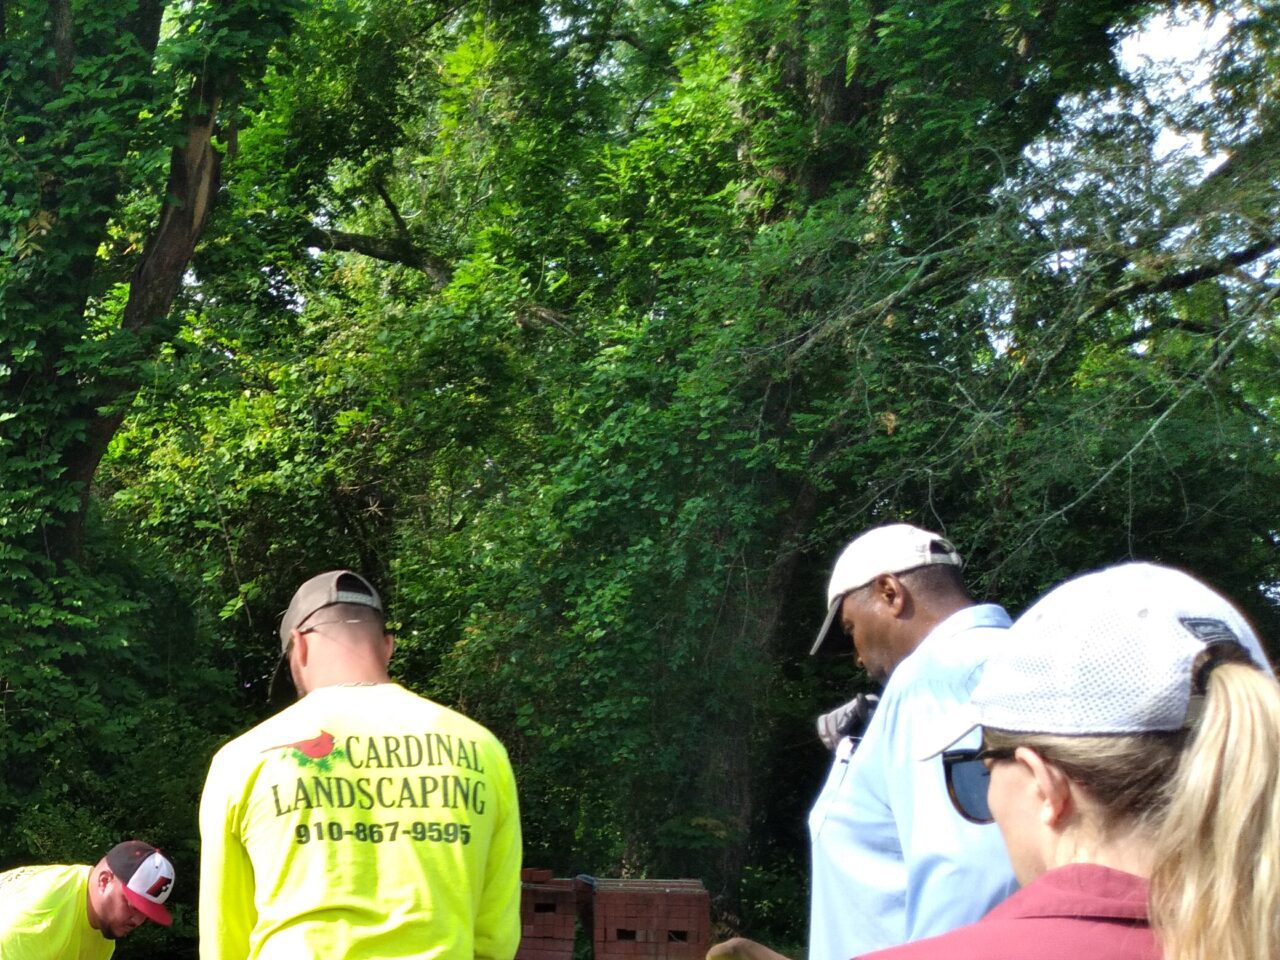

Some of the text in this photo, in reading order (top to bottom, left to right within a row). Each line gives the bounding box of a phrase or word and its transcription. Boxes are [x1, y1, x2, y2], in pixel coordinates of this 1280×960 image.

[345, 733, 485, 774] CARDINAL
[271, 775, 486, 818] LANDSCAPING
[295, 821, 471, 845] 910-867-9595
